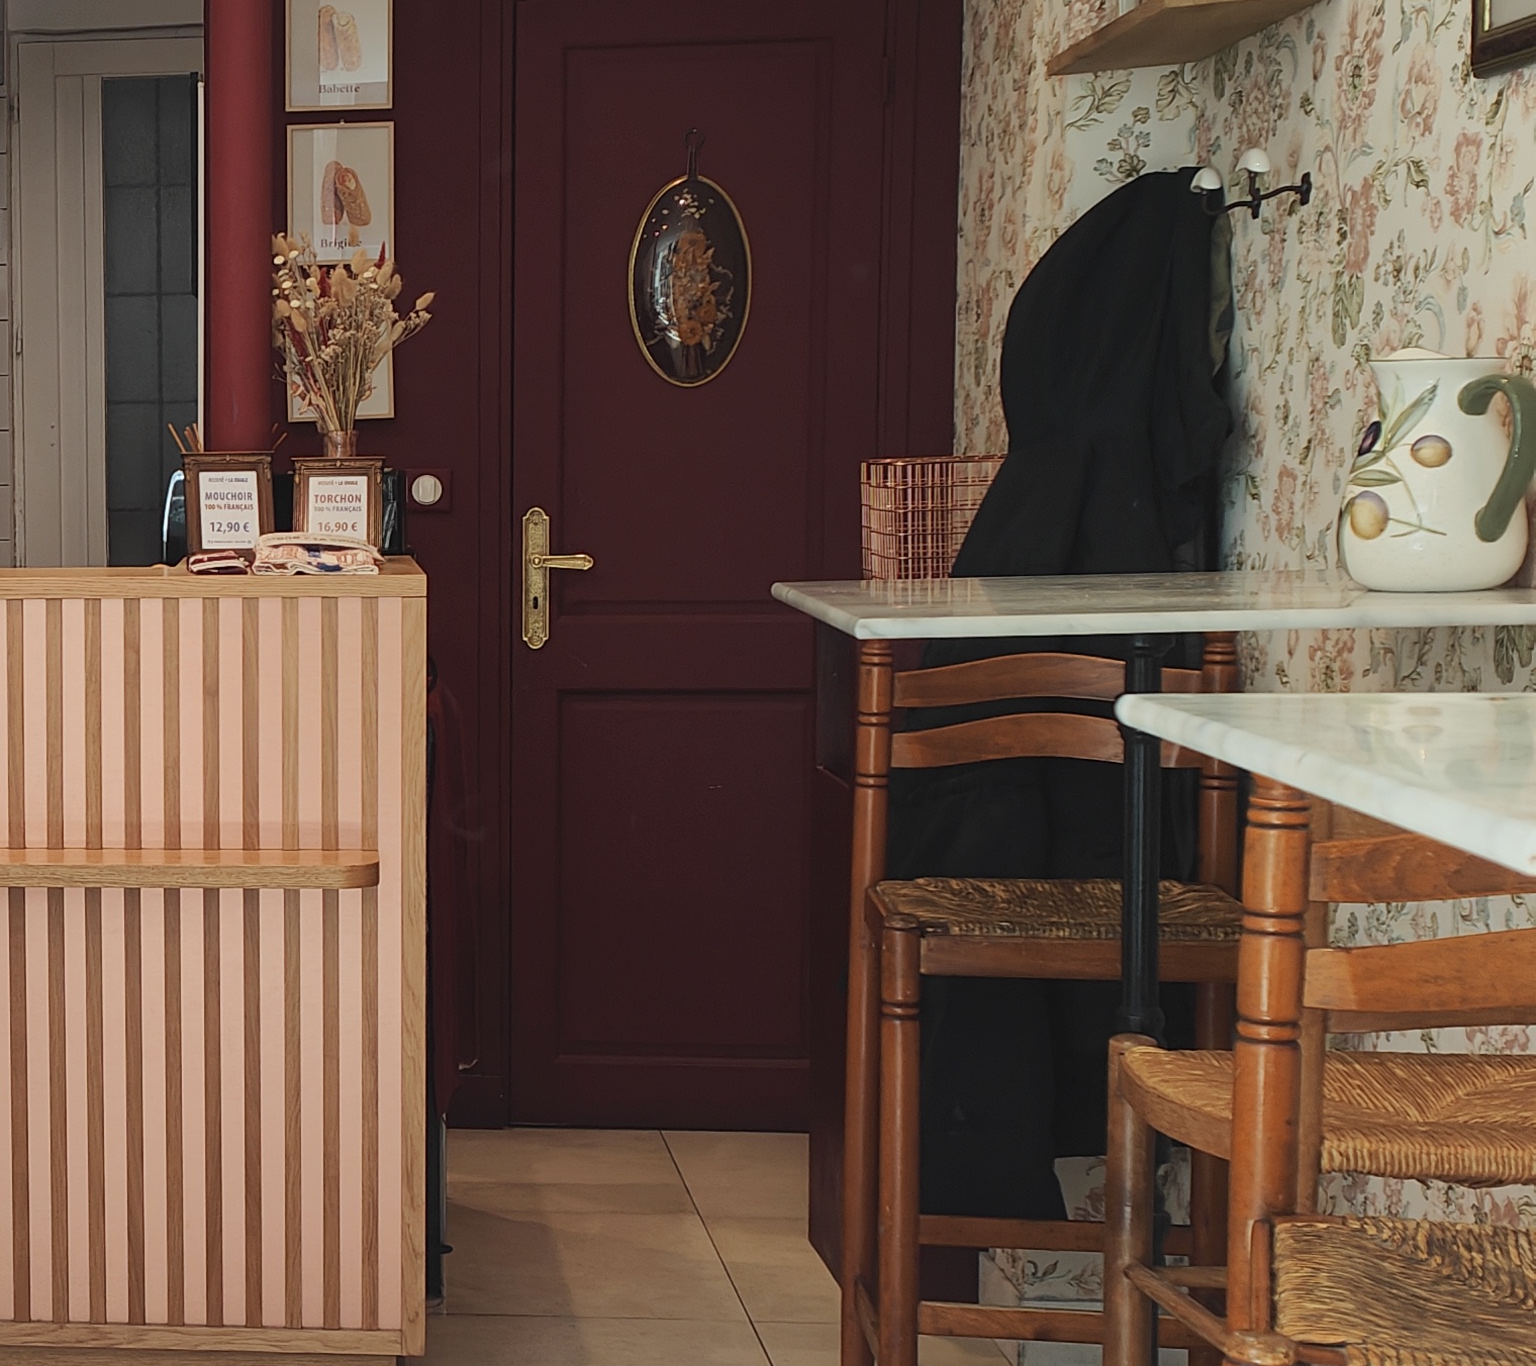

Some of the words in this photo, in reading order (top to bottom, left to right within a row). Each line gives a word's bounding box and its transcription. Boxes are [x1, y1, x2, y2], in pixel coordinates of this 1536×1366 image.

[319, 84, 361, 94] Babette
[320, 238, 362, 250] Brigie
[205, 491, 253, 501] MOUCHOIR
[314, 494, 362, 504] TORCHON
[224, 502, 254, 512] FRANÇAIS
[332, 505, 362, 514] FRANÇAIS
[210, 522, 240, 534] 12,90
[243, 522, 250, 532] €
[318, 522, 348, 533] 16,90
[351, 521, 358, 531] €
